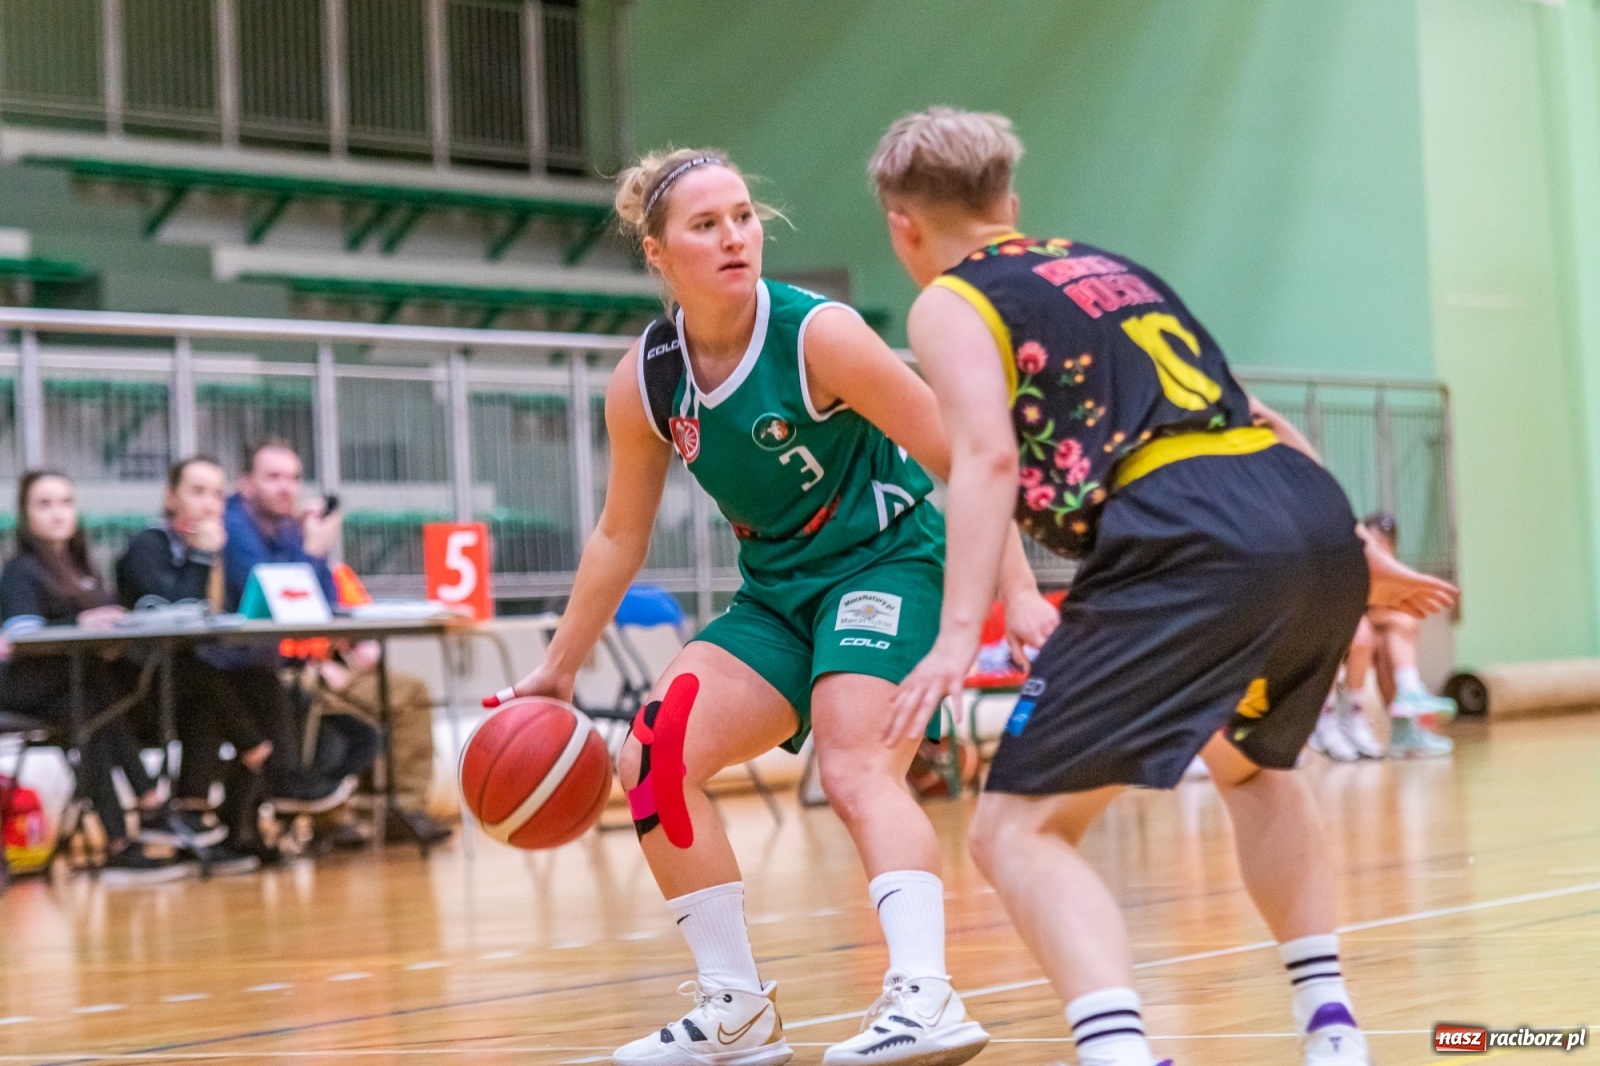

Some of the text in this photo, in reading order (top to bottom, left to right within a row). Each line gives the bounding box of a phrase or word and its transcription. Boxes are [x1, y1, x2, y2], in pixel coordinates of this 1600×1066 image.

[779, 445, 824, 492] 3
[436, 530, 479, 603] 5
[839, 637, 891, 650] COLO
